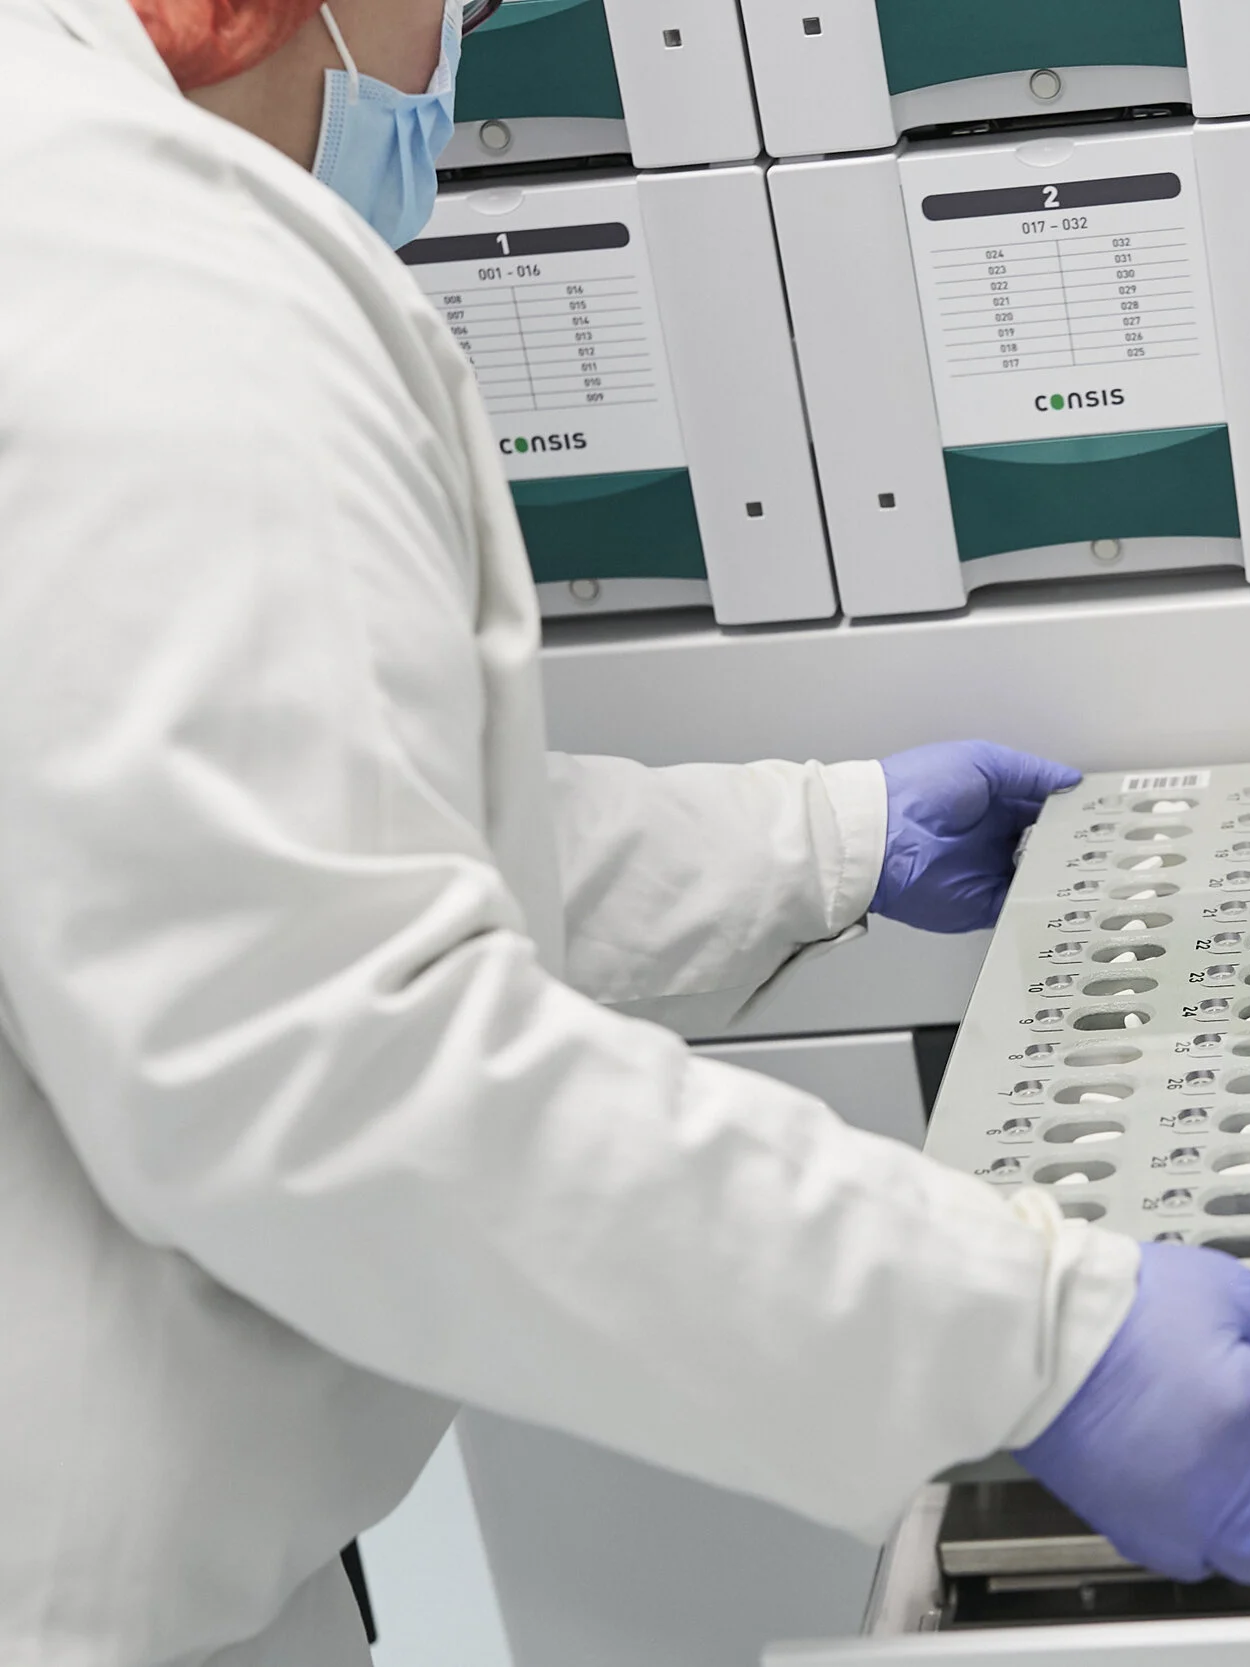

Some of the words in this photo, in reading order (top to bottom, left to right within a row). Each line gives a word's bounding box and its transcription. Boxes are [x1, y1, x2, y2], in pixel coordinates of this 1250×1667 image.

[1042, 186, 1060, 208] 2
[1022, 221, 1045, 234] 017
[1062, 217, 1088, 230] 032
[496, 233, 510, 255] 1
[1113, 238, 1130, 247] 032
[986, 250, 1004, 259] 024
[1115, 254, 1131, 263] 031
[478, 267, 502, 280] 001
[517, 264, 540, 277] 016
[988, 266, 1006, 274] 023
[1117, 270, 1135, 278] 030
[566, 286, 583, 294] 016
[991, 282, 1008, 290] 022
[1119, 286, 1136, 294] 029
[444, 296, 462, 304] 008
[993, 298, 1009, 306] 021
[570, 301, 586, 310] 015
[1121, 302, 1139, 310] 028
[573, 317, 589, 325] 014
[995, 313, 1013, 321] 020
[1123, 317, 1140, 326] 027
[576, 332, 592, 340] 013
[998, 329, 1015, 337] 019
[1125, 333, 1143, 341] 026
[579, 347, 594, 356] 012
[1001, 344, 1017, 352] 018
[1127, 348, 1145, 357] 025
[582, 363, 597, 371] 011
[1003, 360, 1019, 368] 017
[585, 378, 601, 386] 010
[587, 393, 603, 402] 009
[1215, 849, 1229, 858] 19
[1066, 859, 1080, 868] 14
[1209, 878, 1223, 888] 20
[1057, 888, 1071, 897] 13
[1202, 908, 1217, 918] 21
[1048, 919, 1063, 928] 12
[1196, 939, 1211, 950] 22
[1038, 950, 1053, 959] 11
[1189, 972, 1205, 983] 23
[1028, 983, 1044, 993] 10
[1182, 1006, 1198, 1017] 24
[1174, 1042, 1191, 1053] 25
[1167, 1079, 1184, 1090] 26
[1160, 1117, 1176, 1128] 27
